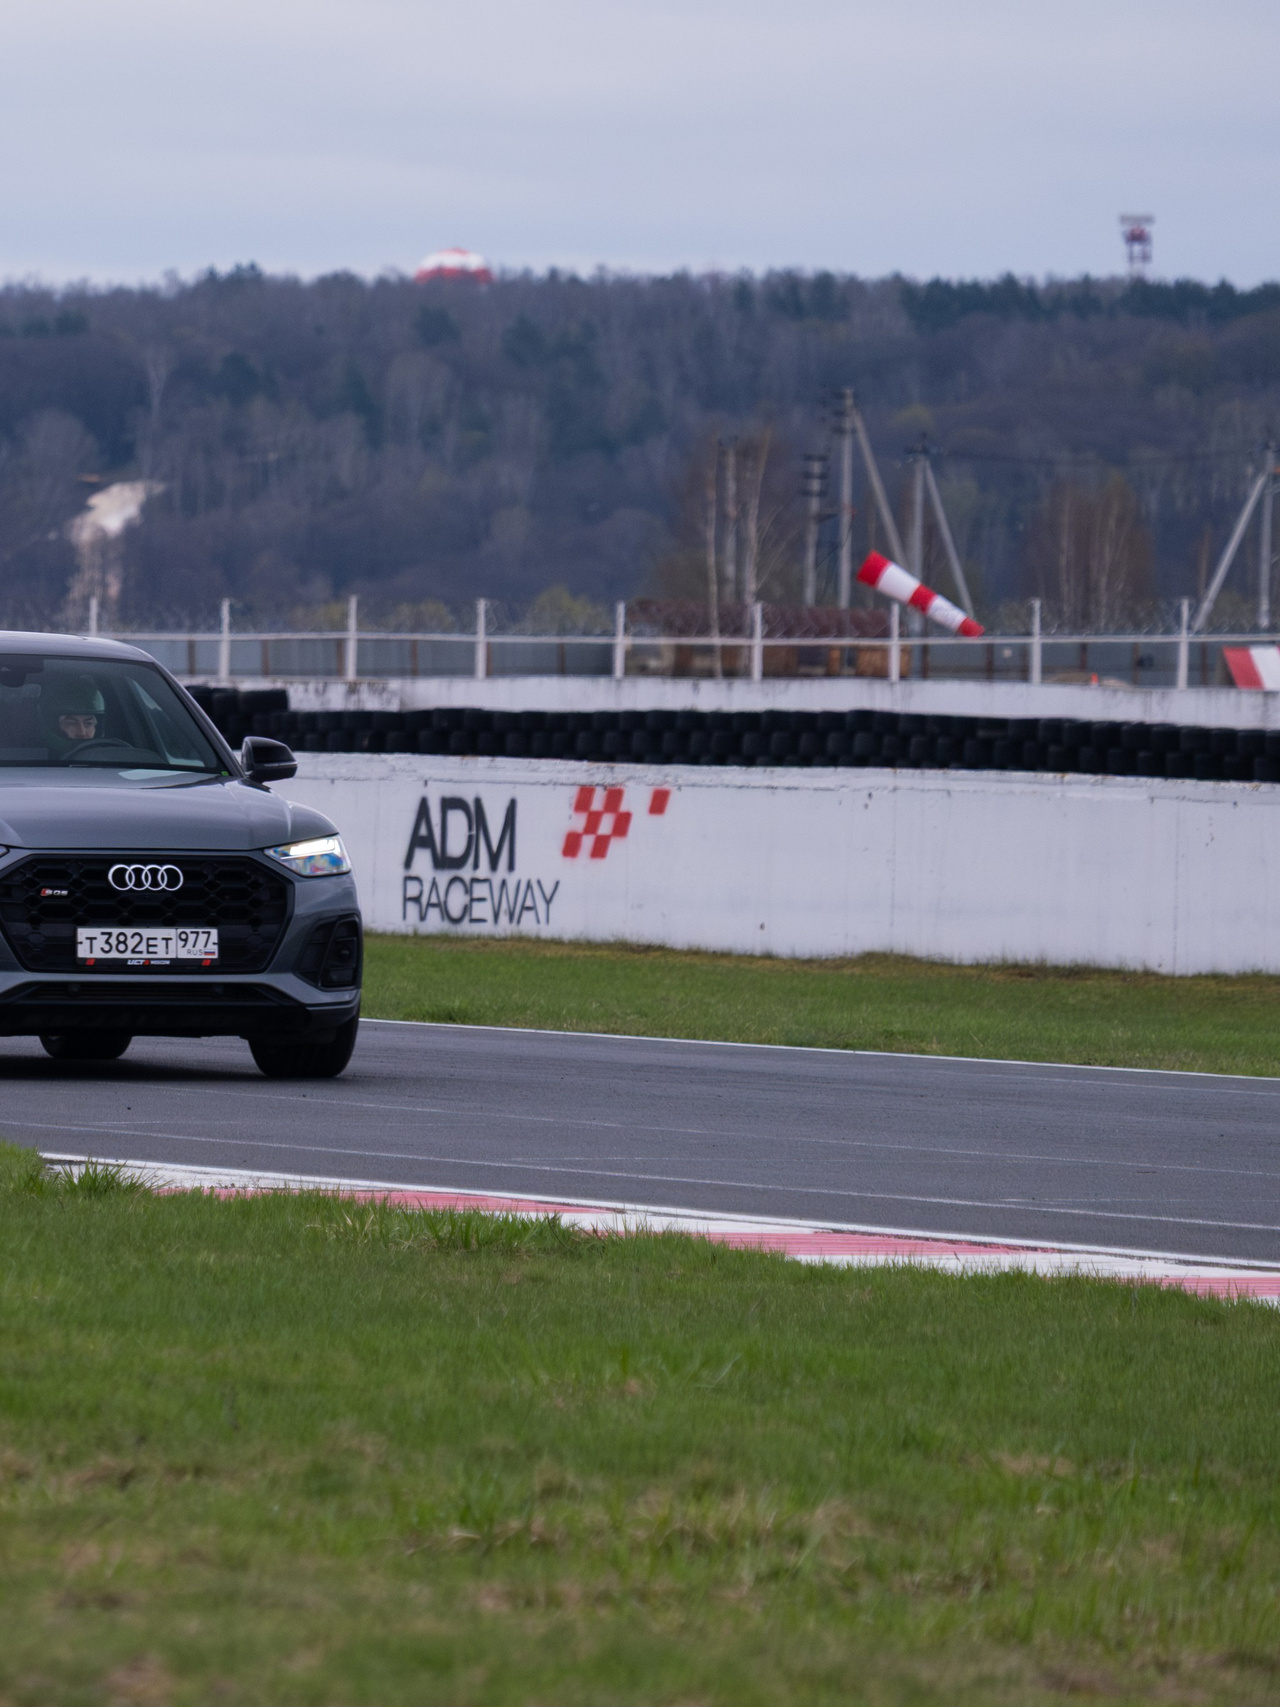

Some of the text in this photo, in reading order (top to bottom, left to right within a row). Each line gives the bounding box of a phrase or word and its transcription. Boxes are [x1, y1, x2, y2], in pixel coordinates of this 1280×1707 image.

[404, 796, 517, 872] ADM
[402, 876, 560, 925] RACEWAY
[178, 931, 211, 948] 977
